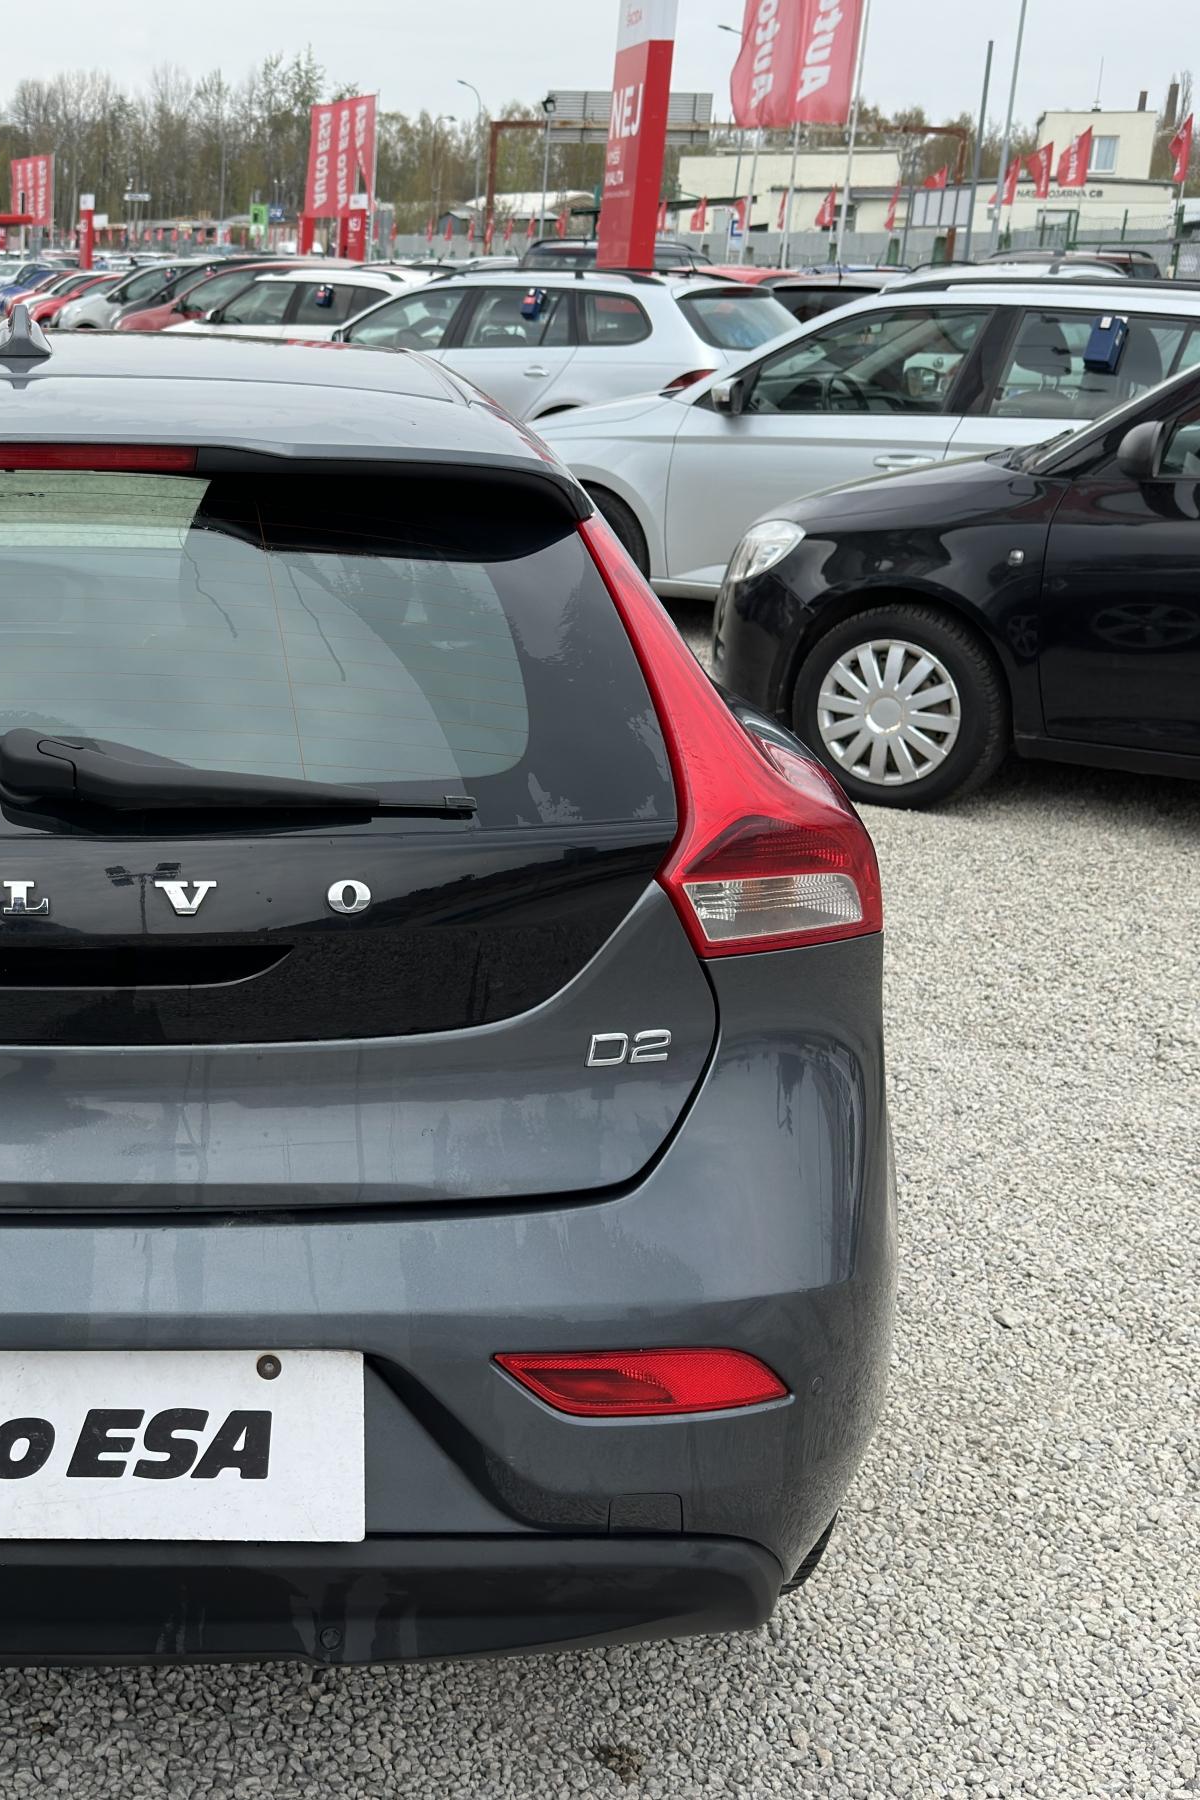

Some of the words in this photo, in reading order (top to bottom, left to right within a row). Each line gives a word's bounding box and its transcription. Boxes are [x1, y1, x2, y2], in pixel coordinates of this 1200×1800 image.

[609, 83, 643, 140] NEJ
[586, 1029, 672, 1067] D2
[65, 1408, 273, 1479] ESA
